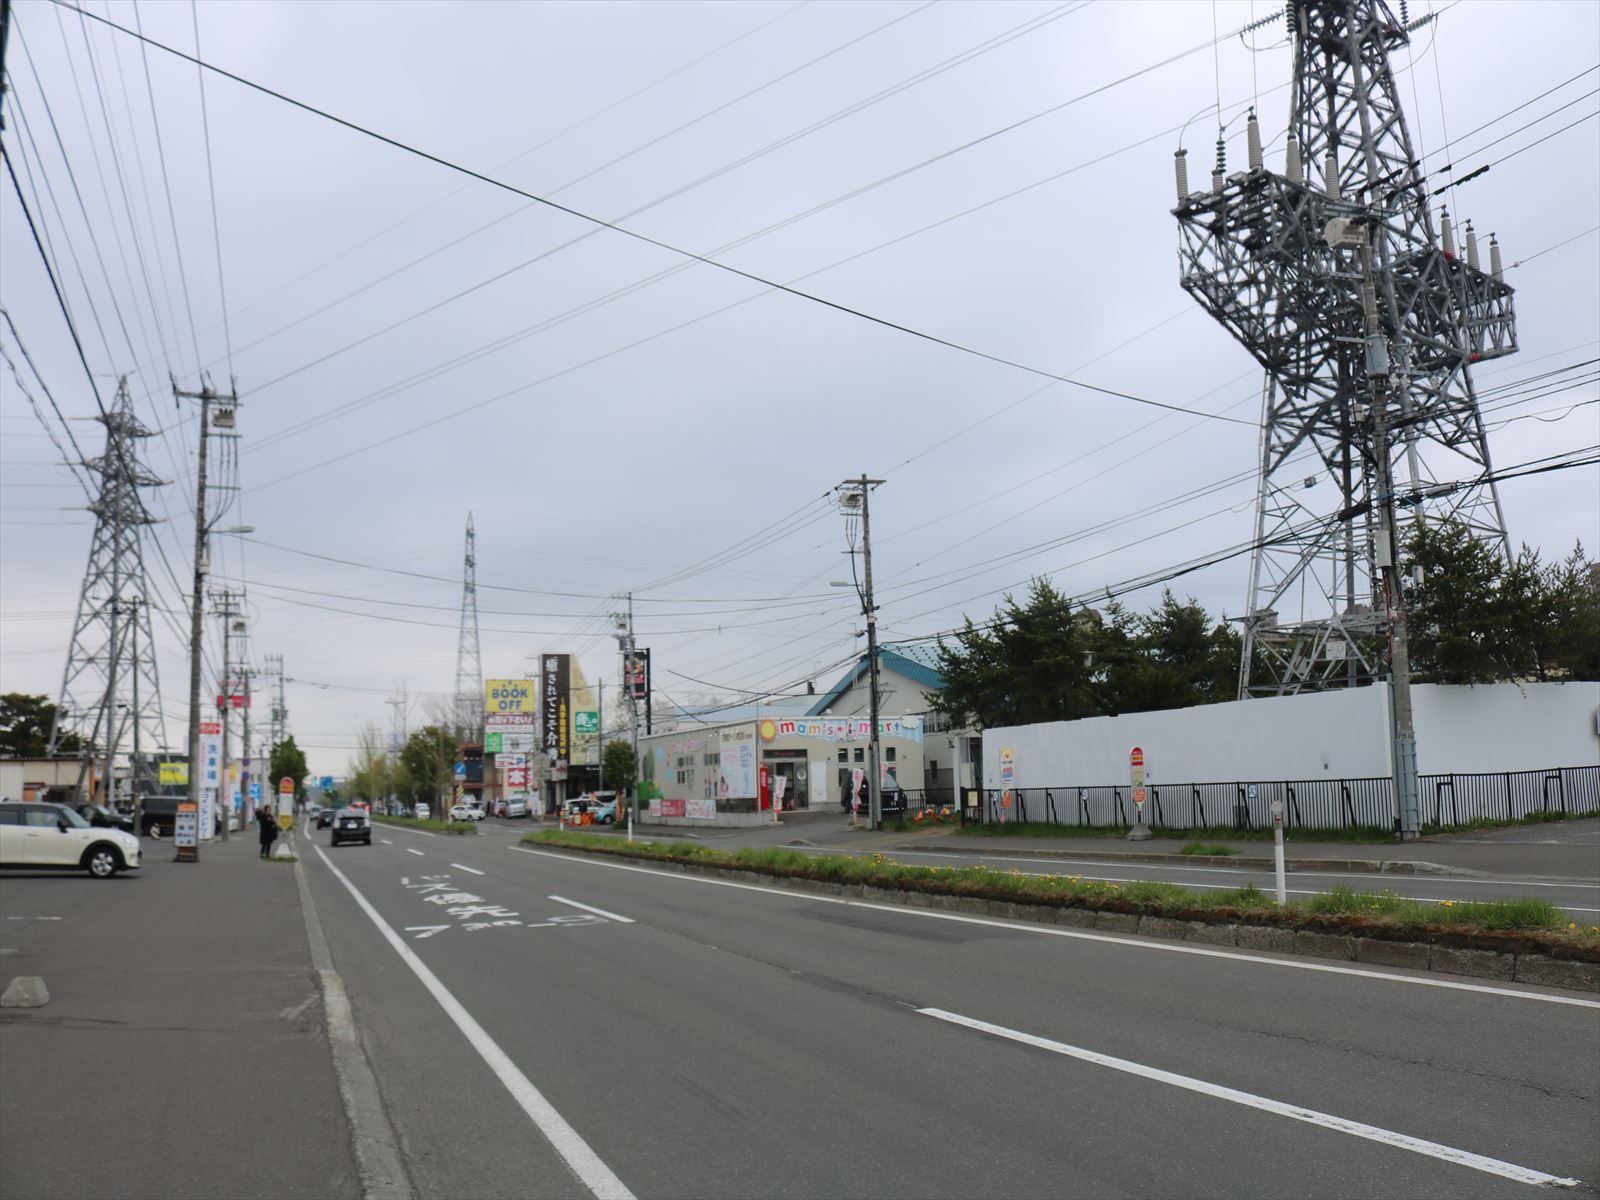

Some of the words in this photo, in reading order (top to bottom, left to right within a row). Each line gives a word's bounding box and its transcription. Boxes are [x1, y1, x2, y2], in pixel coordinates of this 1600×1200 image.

[492, 688, 529, 699] BOOK
[498, 700, 522, 711] OFF
[780, 720, 838, 736] mam's
[509, 769, 526, 784] 本
